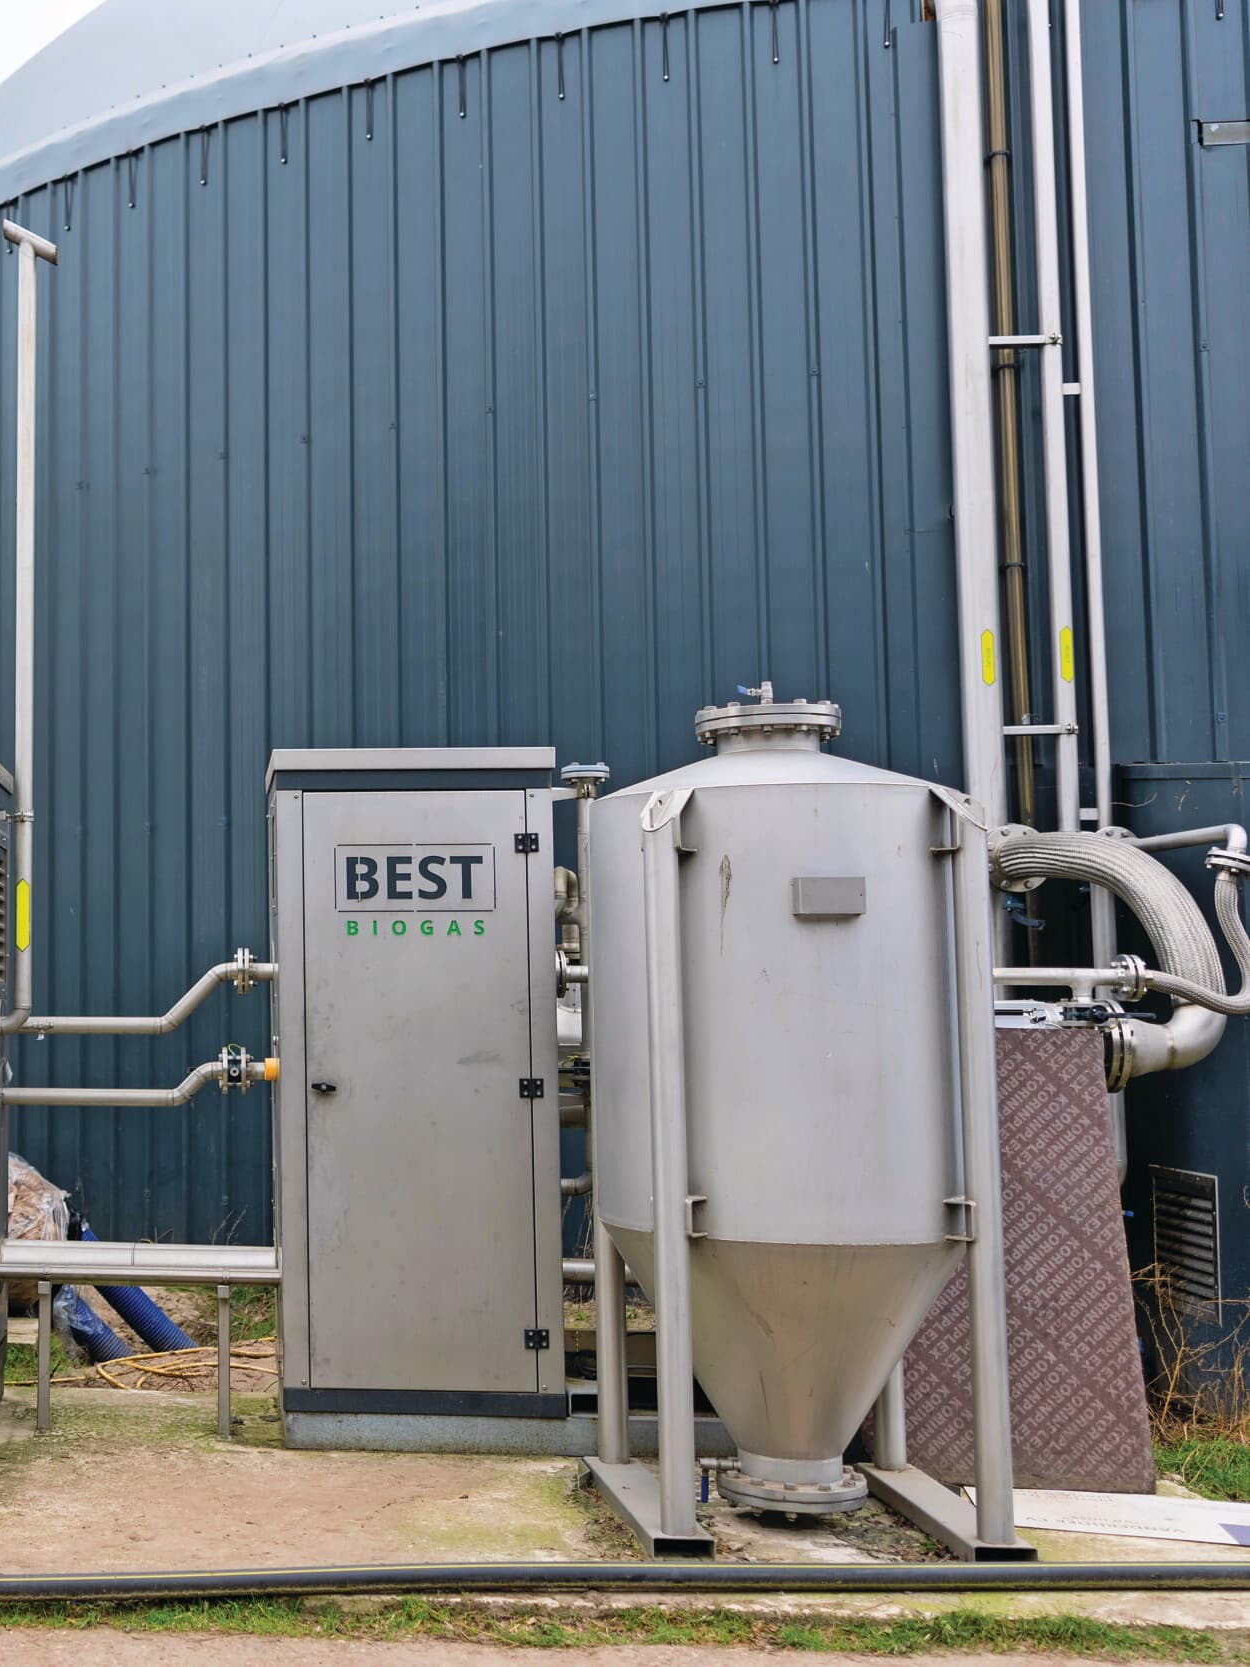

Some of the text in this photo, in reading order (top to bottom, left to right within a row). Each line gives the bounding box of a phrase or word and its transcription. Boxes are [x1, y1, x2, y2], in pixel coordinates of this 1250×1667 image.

[345, 855, 483, 900] BEST
[346, 920, 485, 936] BIOGAS
[1000, 1093, 1068, 1158] KORINPLEX
[1013, 1104, 1079, 1169] KORINPLEX
[1023, 1115, 1091, 1180] KORINPLEX
[1035, 1126, 1102, 1191] KORINPLEX
[1011, 1236, 1080, 1304] KORINPLEX
[1022, 1247, 1091, 1316] KORINPLEX
[1057, 1282, 1127, 1350] KORINPLEX
